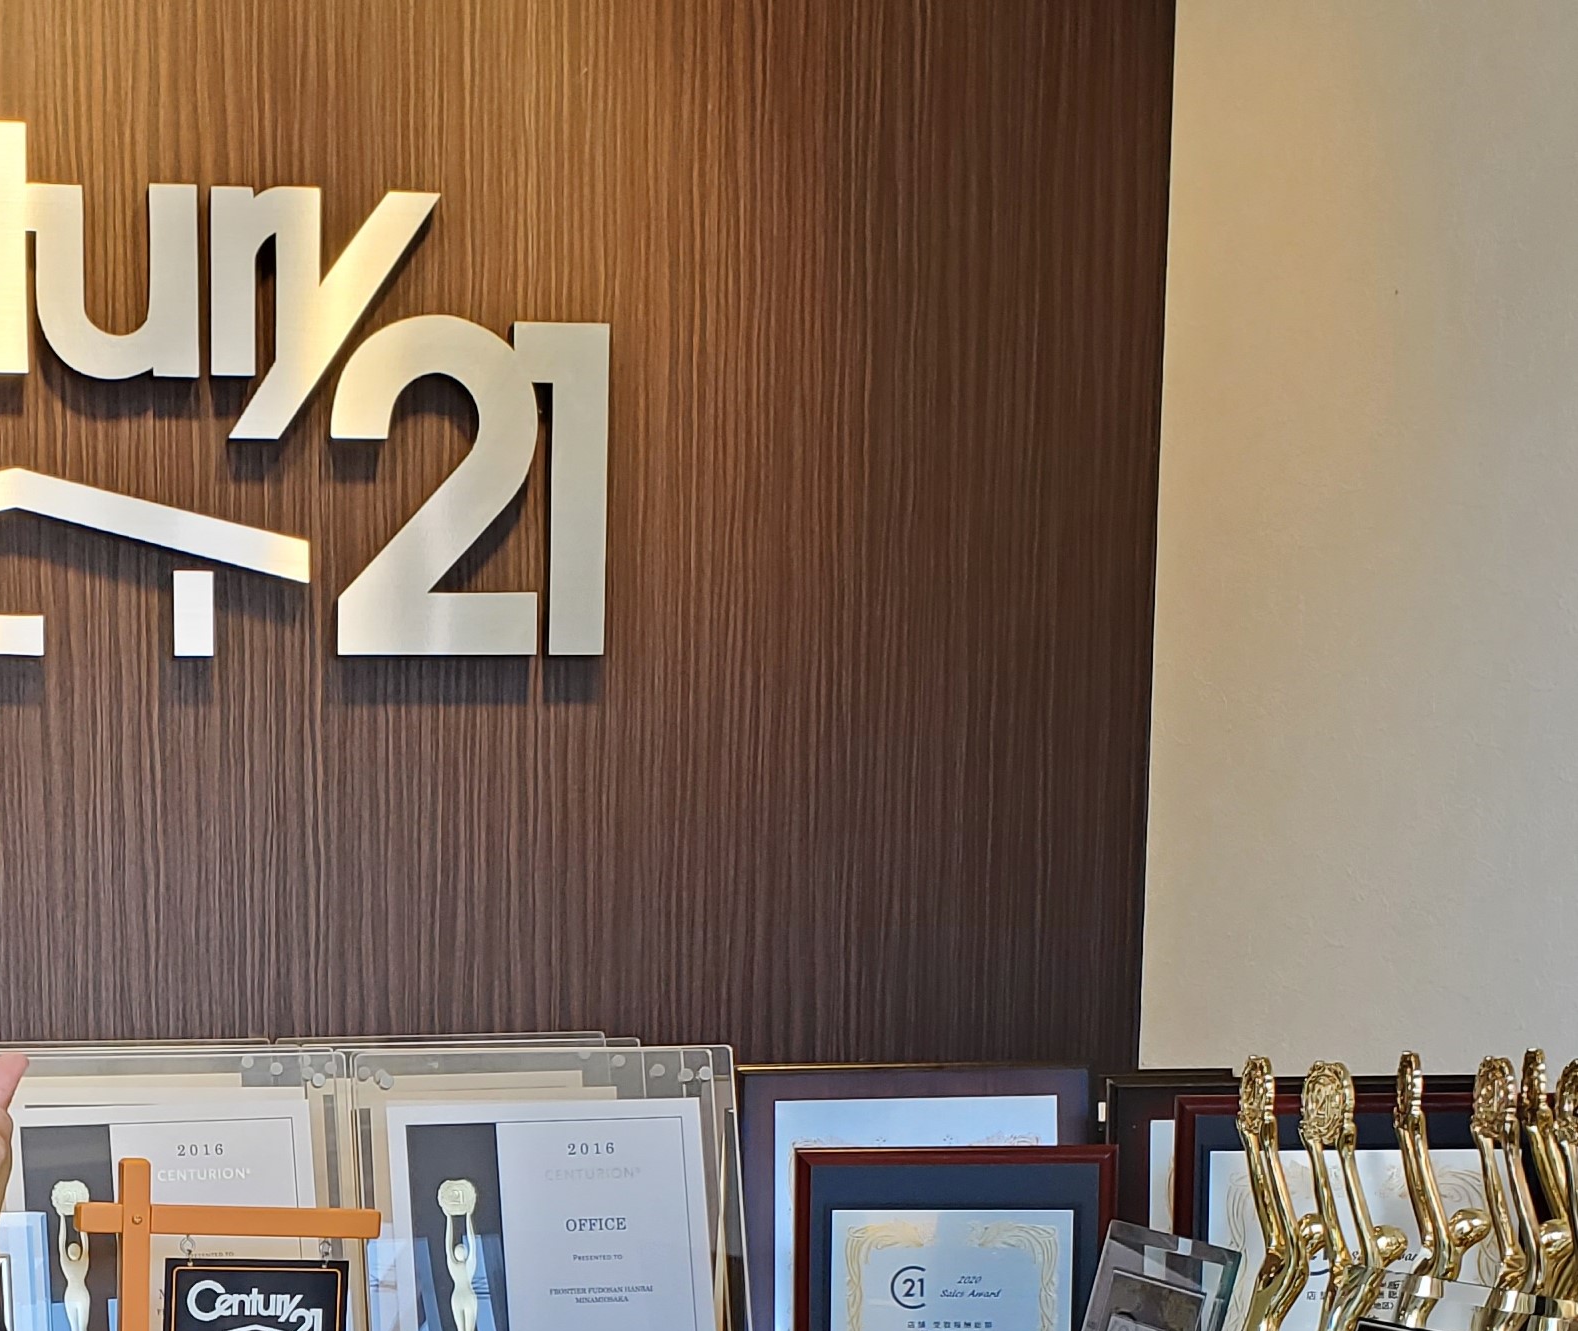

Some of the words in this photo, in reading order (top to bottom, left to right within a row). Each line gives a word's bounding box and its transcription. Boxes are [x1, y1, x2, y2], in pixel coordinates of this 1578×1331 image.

[330, 315, 610, 656] 21
[177, 1143, 224, 1157] 2016
[567, 1142, 615, 1156] 2016
[565, 1217, 627, 1232] OFFICE
[187, 1280, 303, 1322] Century
